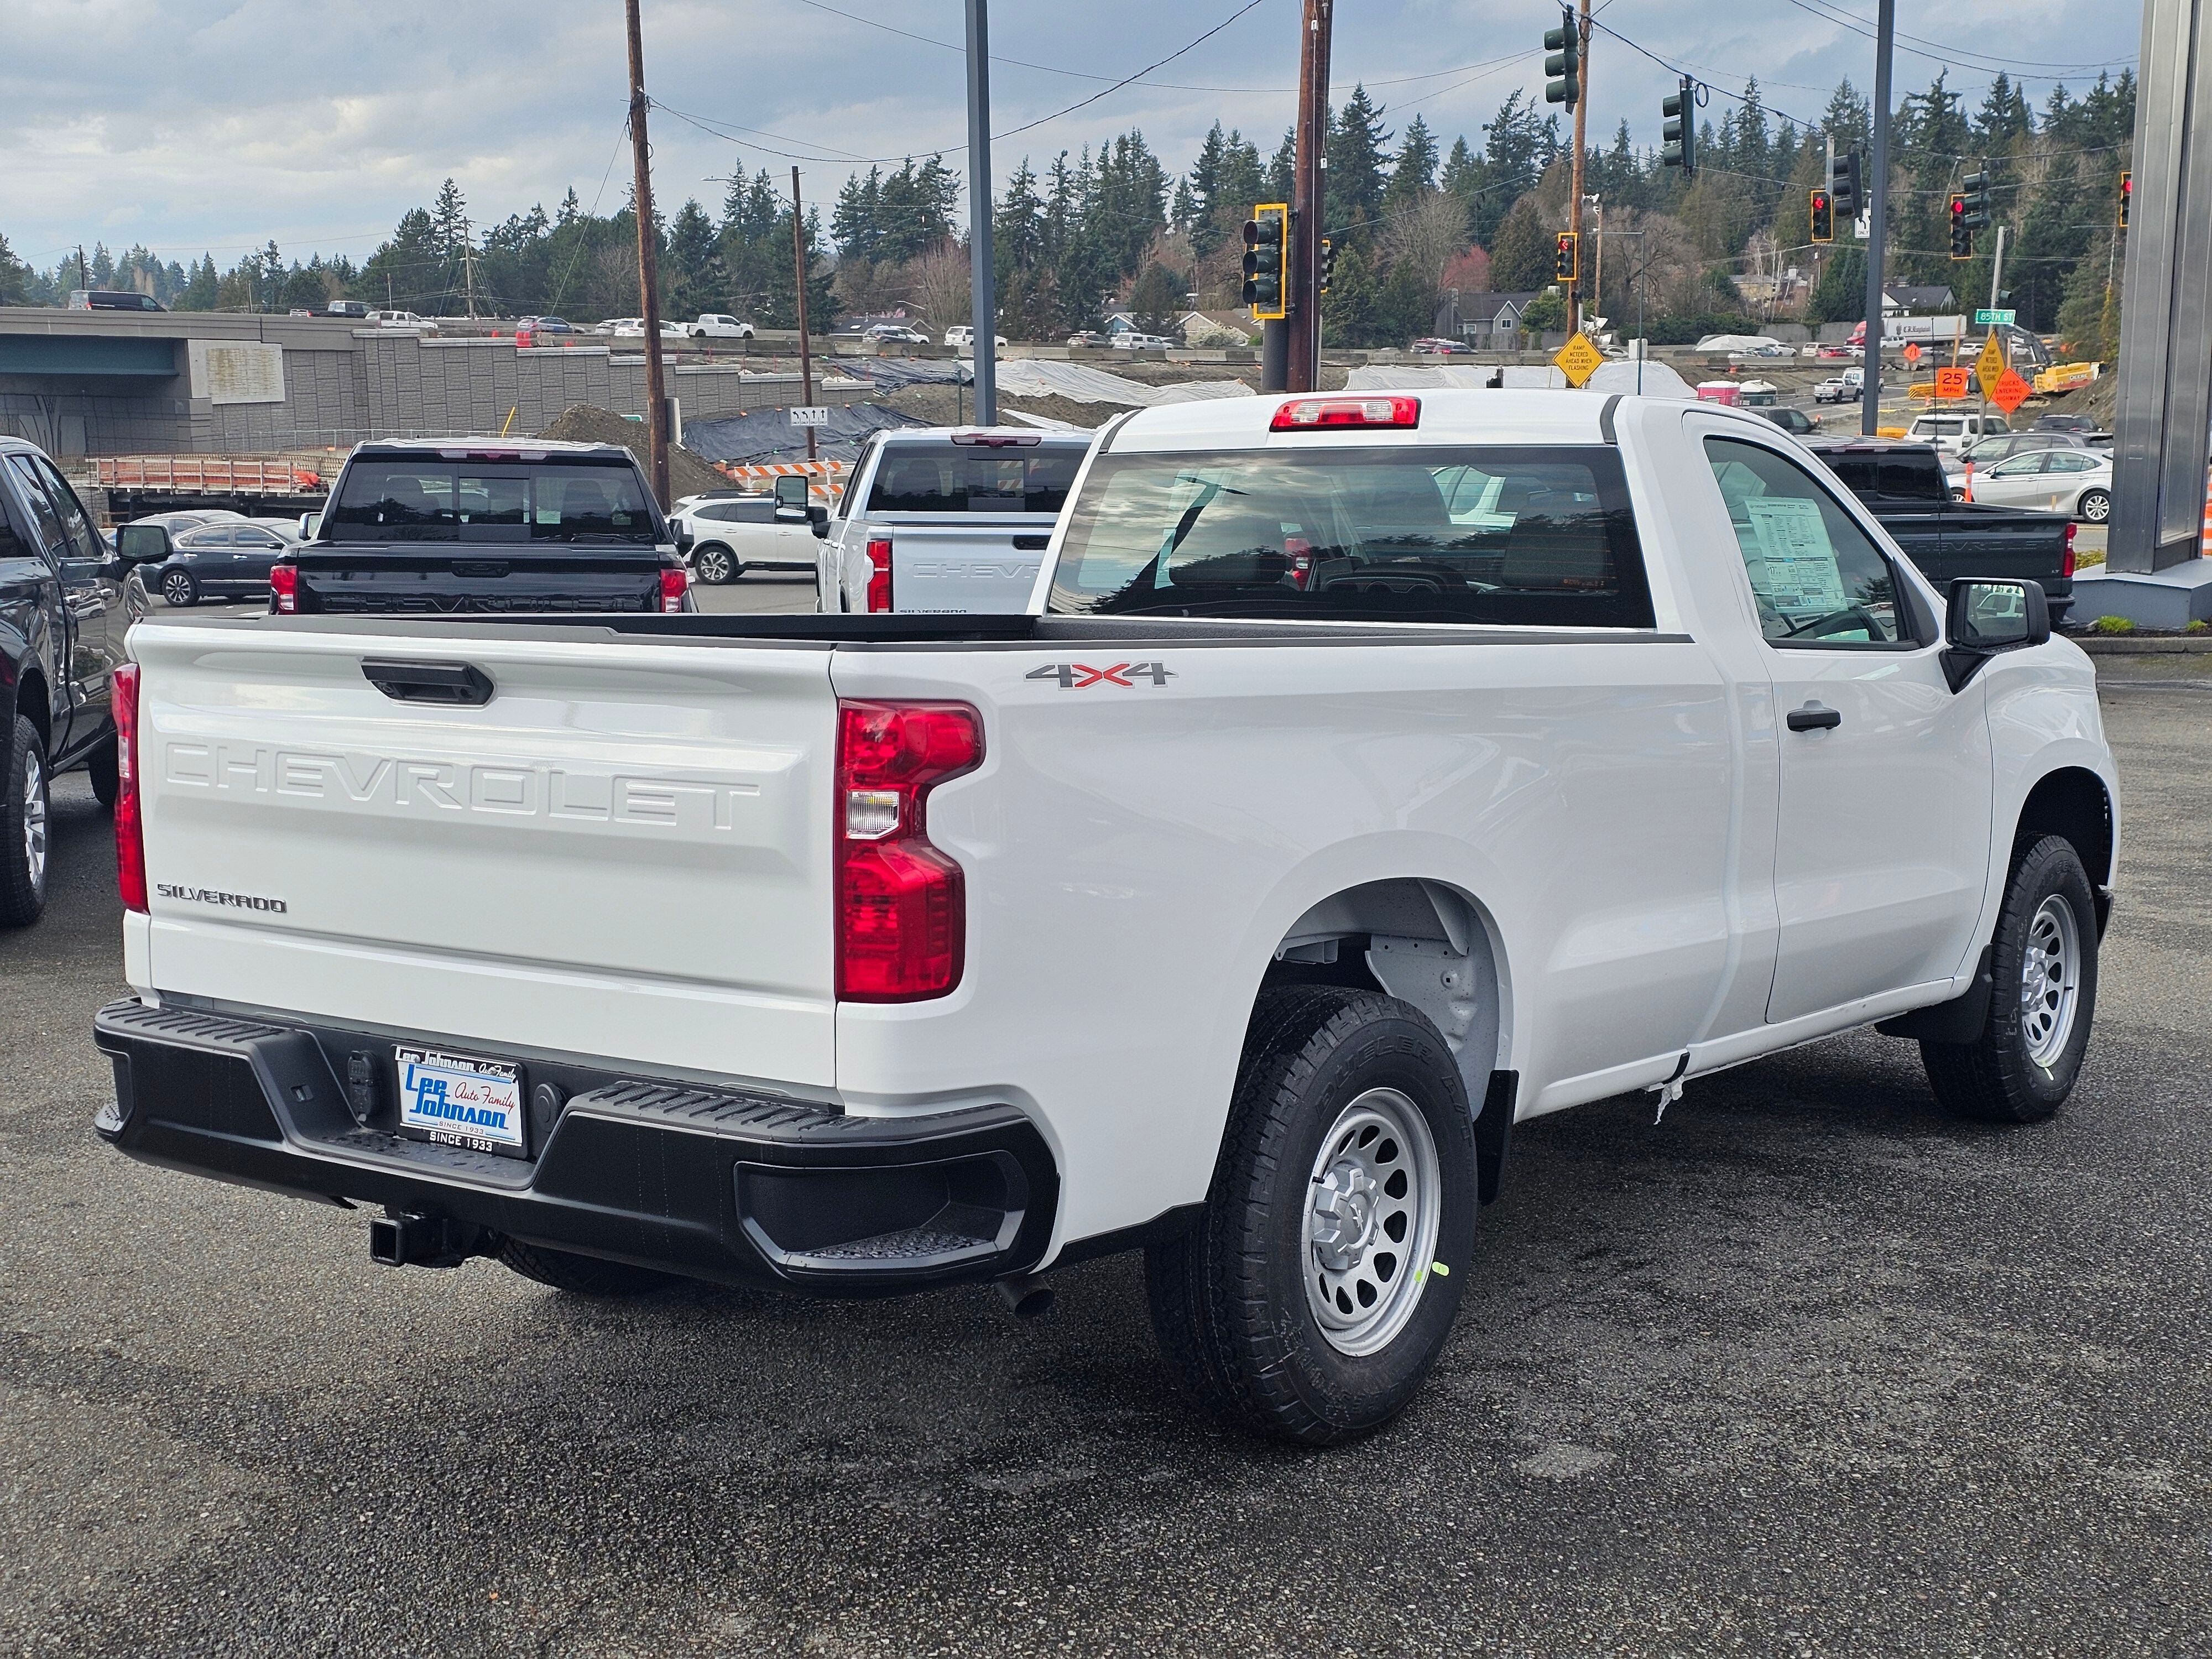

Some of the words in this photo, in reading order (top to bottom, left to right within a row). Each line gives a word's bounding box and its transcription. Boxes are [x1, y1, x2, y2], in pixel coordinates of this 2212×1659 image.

[1981, 312, 2001, 321] 85TH
[1942, 373, 1962, 384] 25
[165, 740, 761, 831] CHEVROLET
[157, 883, 287, 913] SILVERADO
[421, 1051, 476, 1072] Johnson
[405, 1064, 450, 1097] Lee
[409, 1091, 509, 1130] Johnson
[455, 1082, 479, 1101] Auto
[480, 1086, 515, 1115] Family
[439, 1121, 462, 1130] SINCE
[466, 1126, 484, 1134] 1933
[429, 1131, 462, 1146] SINCE
[467, 1138, 493, 1152] 1933
